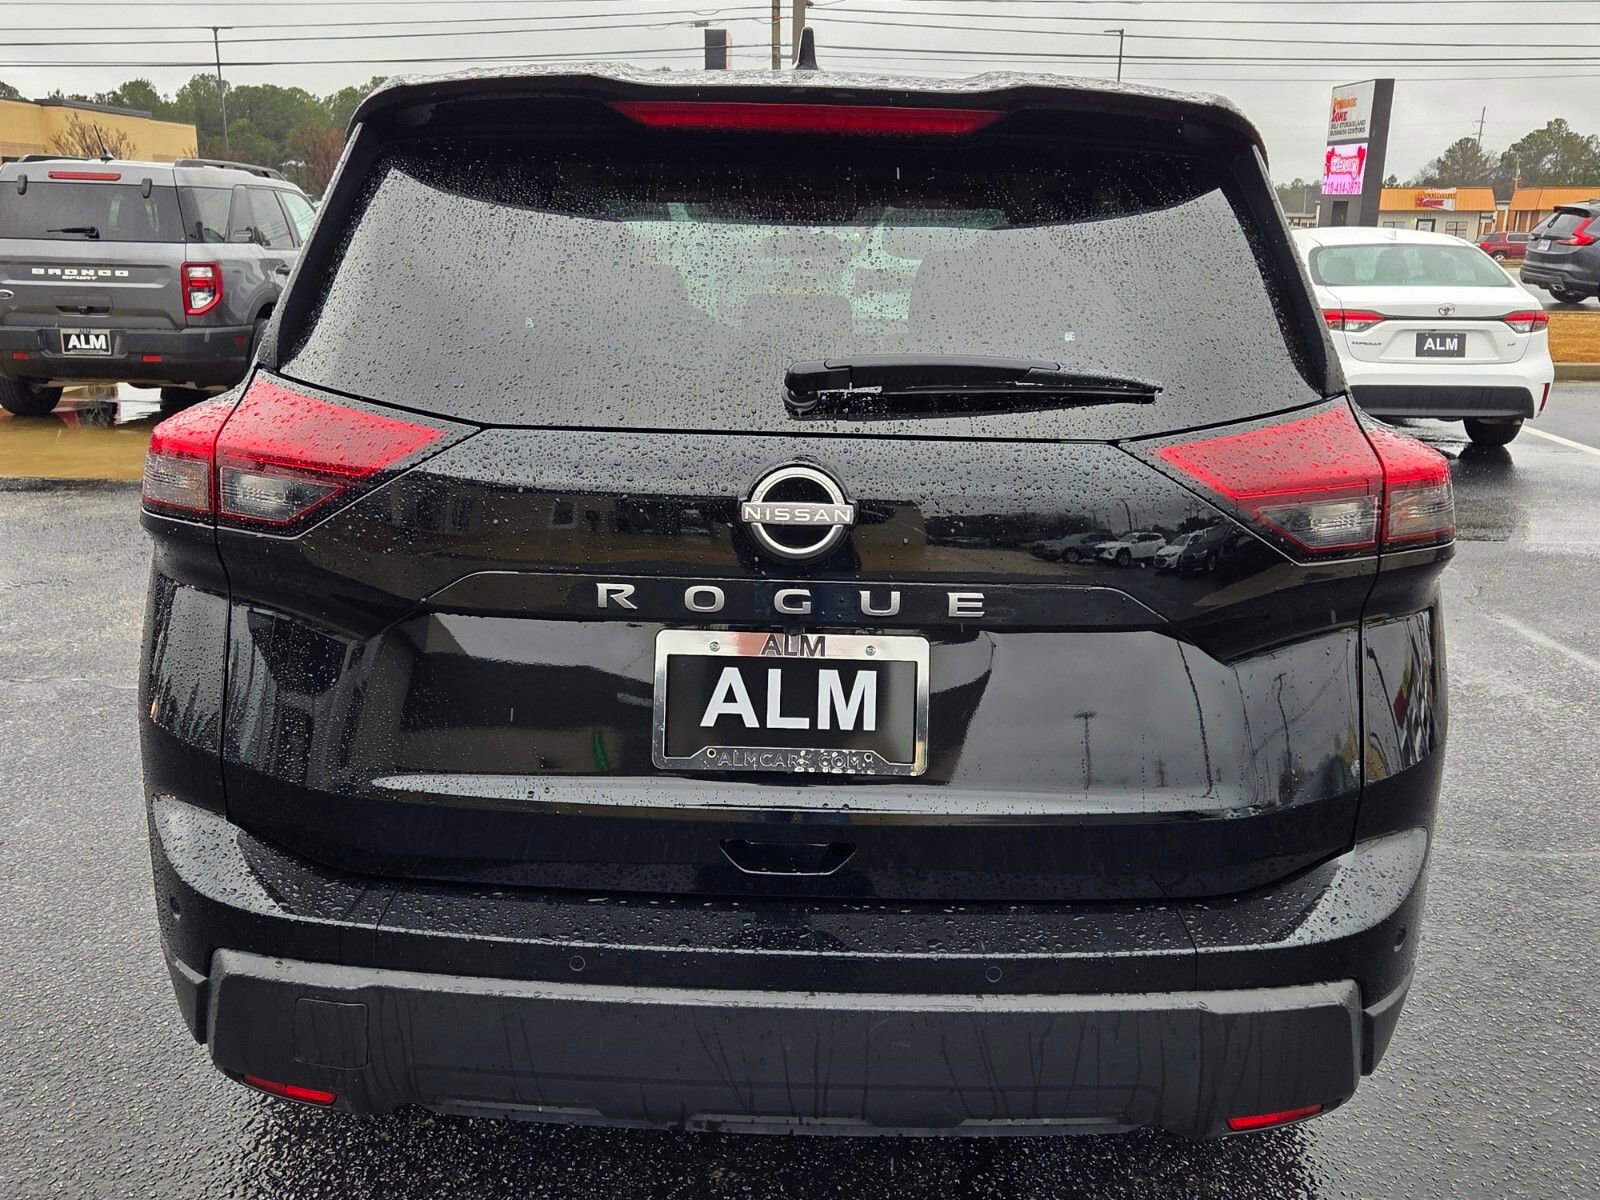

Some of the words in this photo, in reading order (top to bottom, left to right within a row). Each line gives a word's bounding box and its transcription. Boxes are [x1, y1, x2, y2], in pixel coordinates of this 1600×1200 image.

[31, 268, 129, 277] BRONCO
[67, 334, 107, 349] ALM
[1423, 337, 1459, 351] ALM
[744, 506, 852, 523] NISSAN
[596, 582, 986, 618] ROGUE
[761, 634, 826, 657] ALM
[699, 666, 877, 732] ALM
[717, 751, 861, 769] ALMCARSCOM
